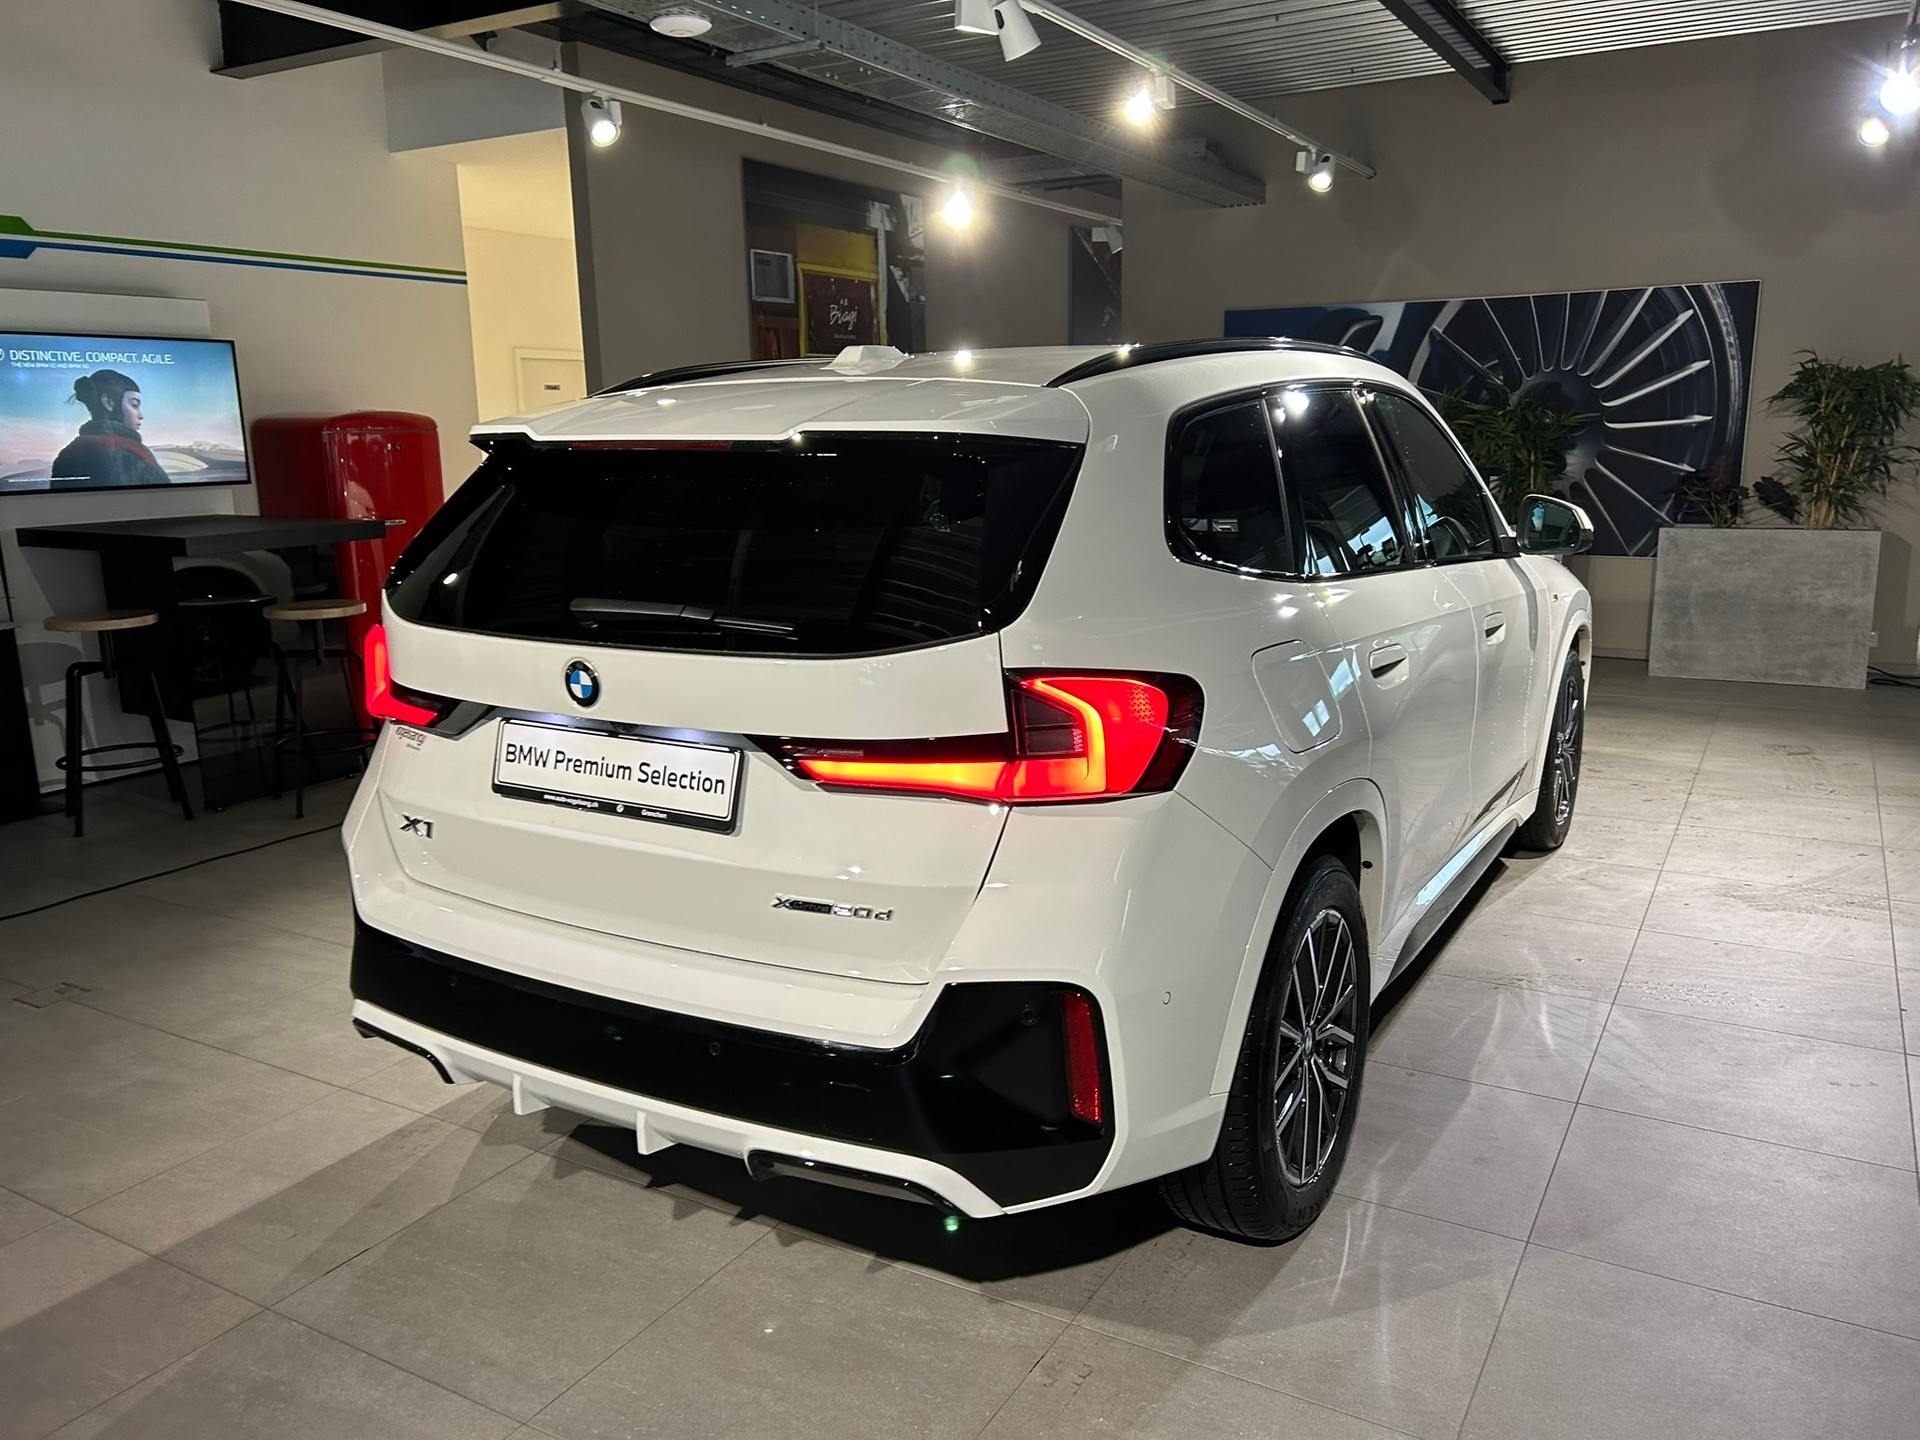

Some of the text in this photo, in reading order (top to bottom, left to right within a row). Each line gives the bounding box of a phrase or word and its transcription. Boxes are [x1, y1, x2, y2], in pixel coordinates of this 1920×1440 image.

[9, 349, 175, 365] DISTINCTIVE. COMPACT. AGILE.
[505, 743, 726, 795] BMW Premium Selection
[399, 813, 434, 840] X1
